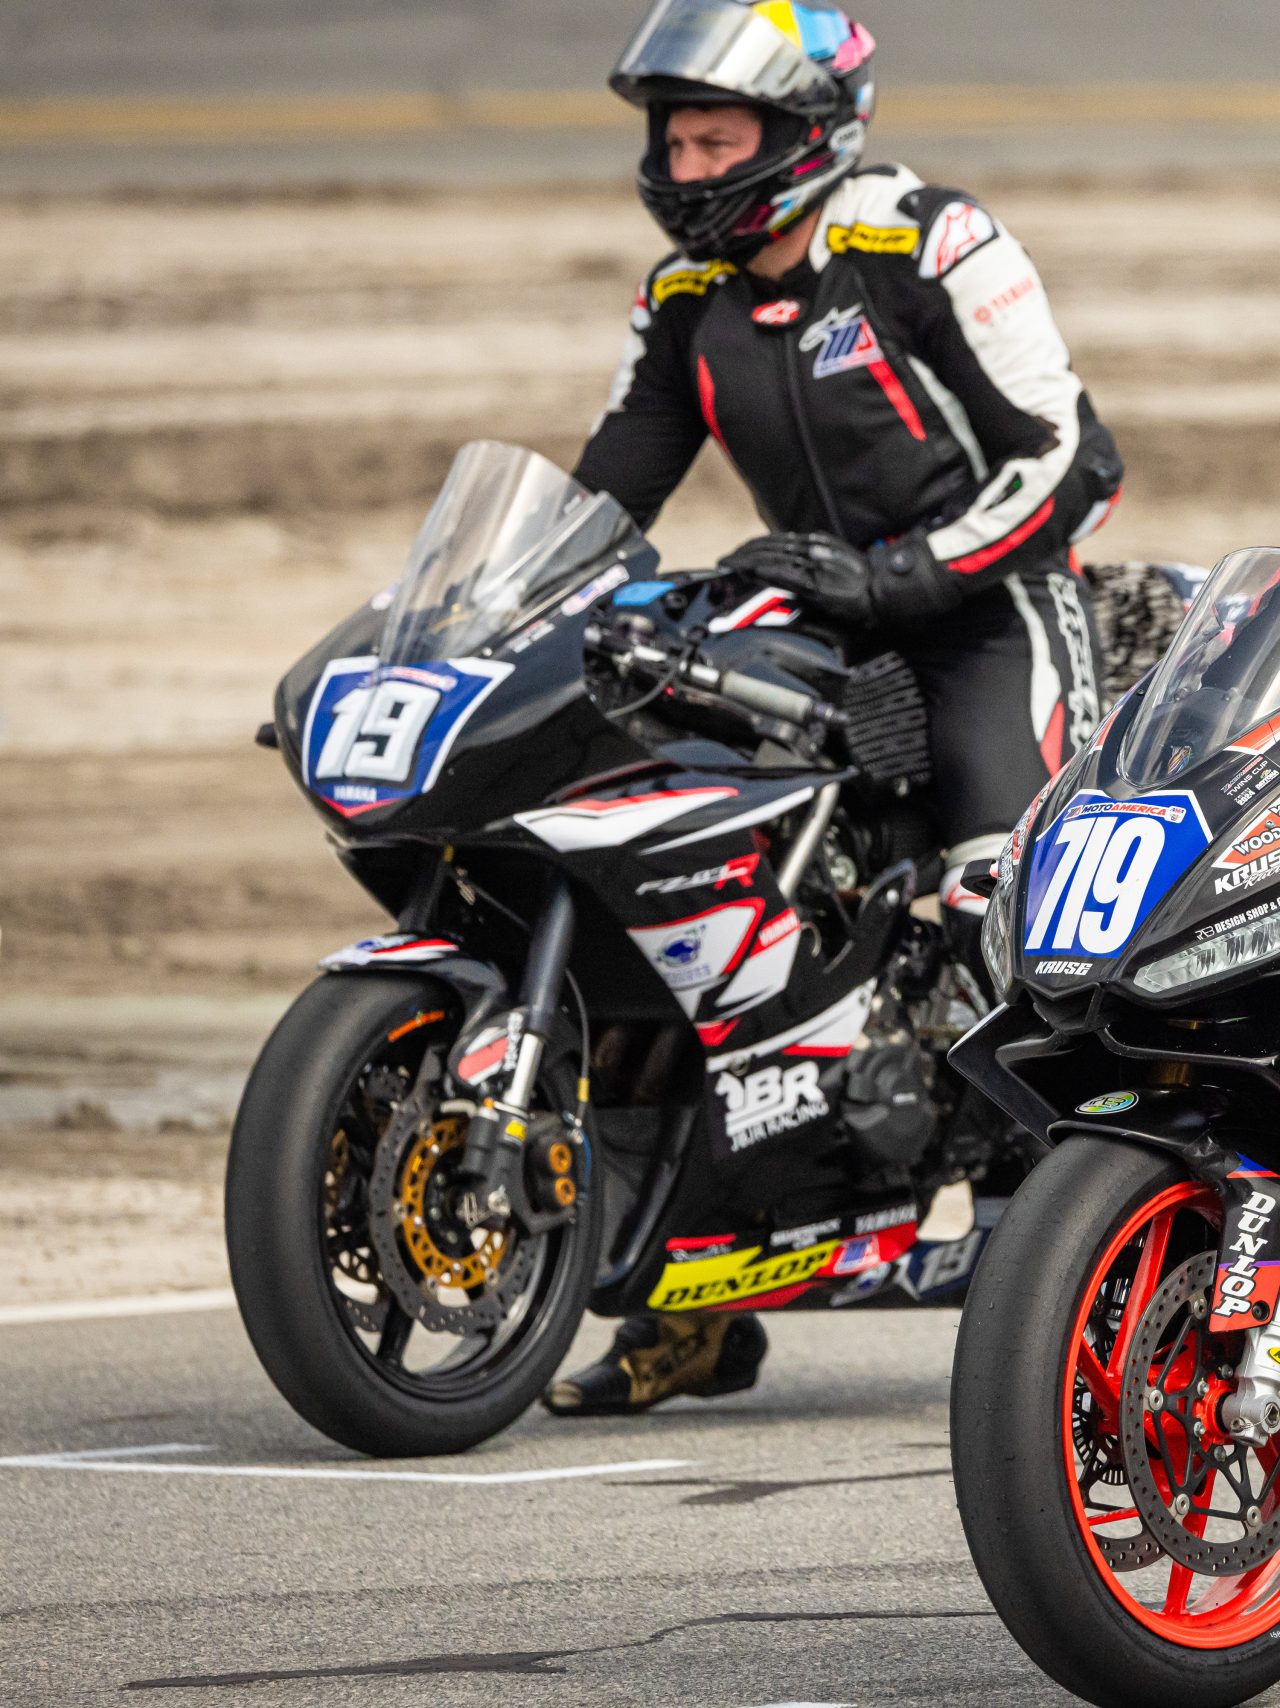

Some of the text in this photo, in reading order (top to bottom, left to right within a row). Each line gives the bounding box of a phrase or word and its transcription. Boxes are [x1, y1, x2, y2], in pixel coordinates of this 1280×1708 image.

[315, 680, 442, 785] 19
[1226, 774, 1253, 796] TWINS
[1251, 760, 1268, 775] CUP
[1081, 802, 1167, 817] MOTOAMERICA
[1024, 816, 1166, 954] 719
[1214, 914, 1247, 934] DESIGN
[1246, 902, 1270, 920] SHOP
[1269, 902, 1278, 911] &
[662, 1251, 828, 1306] DUNLOP
[1213, 1190, 1276, 1317] DUNLOP
